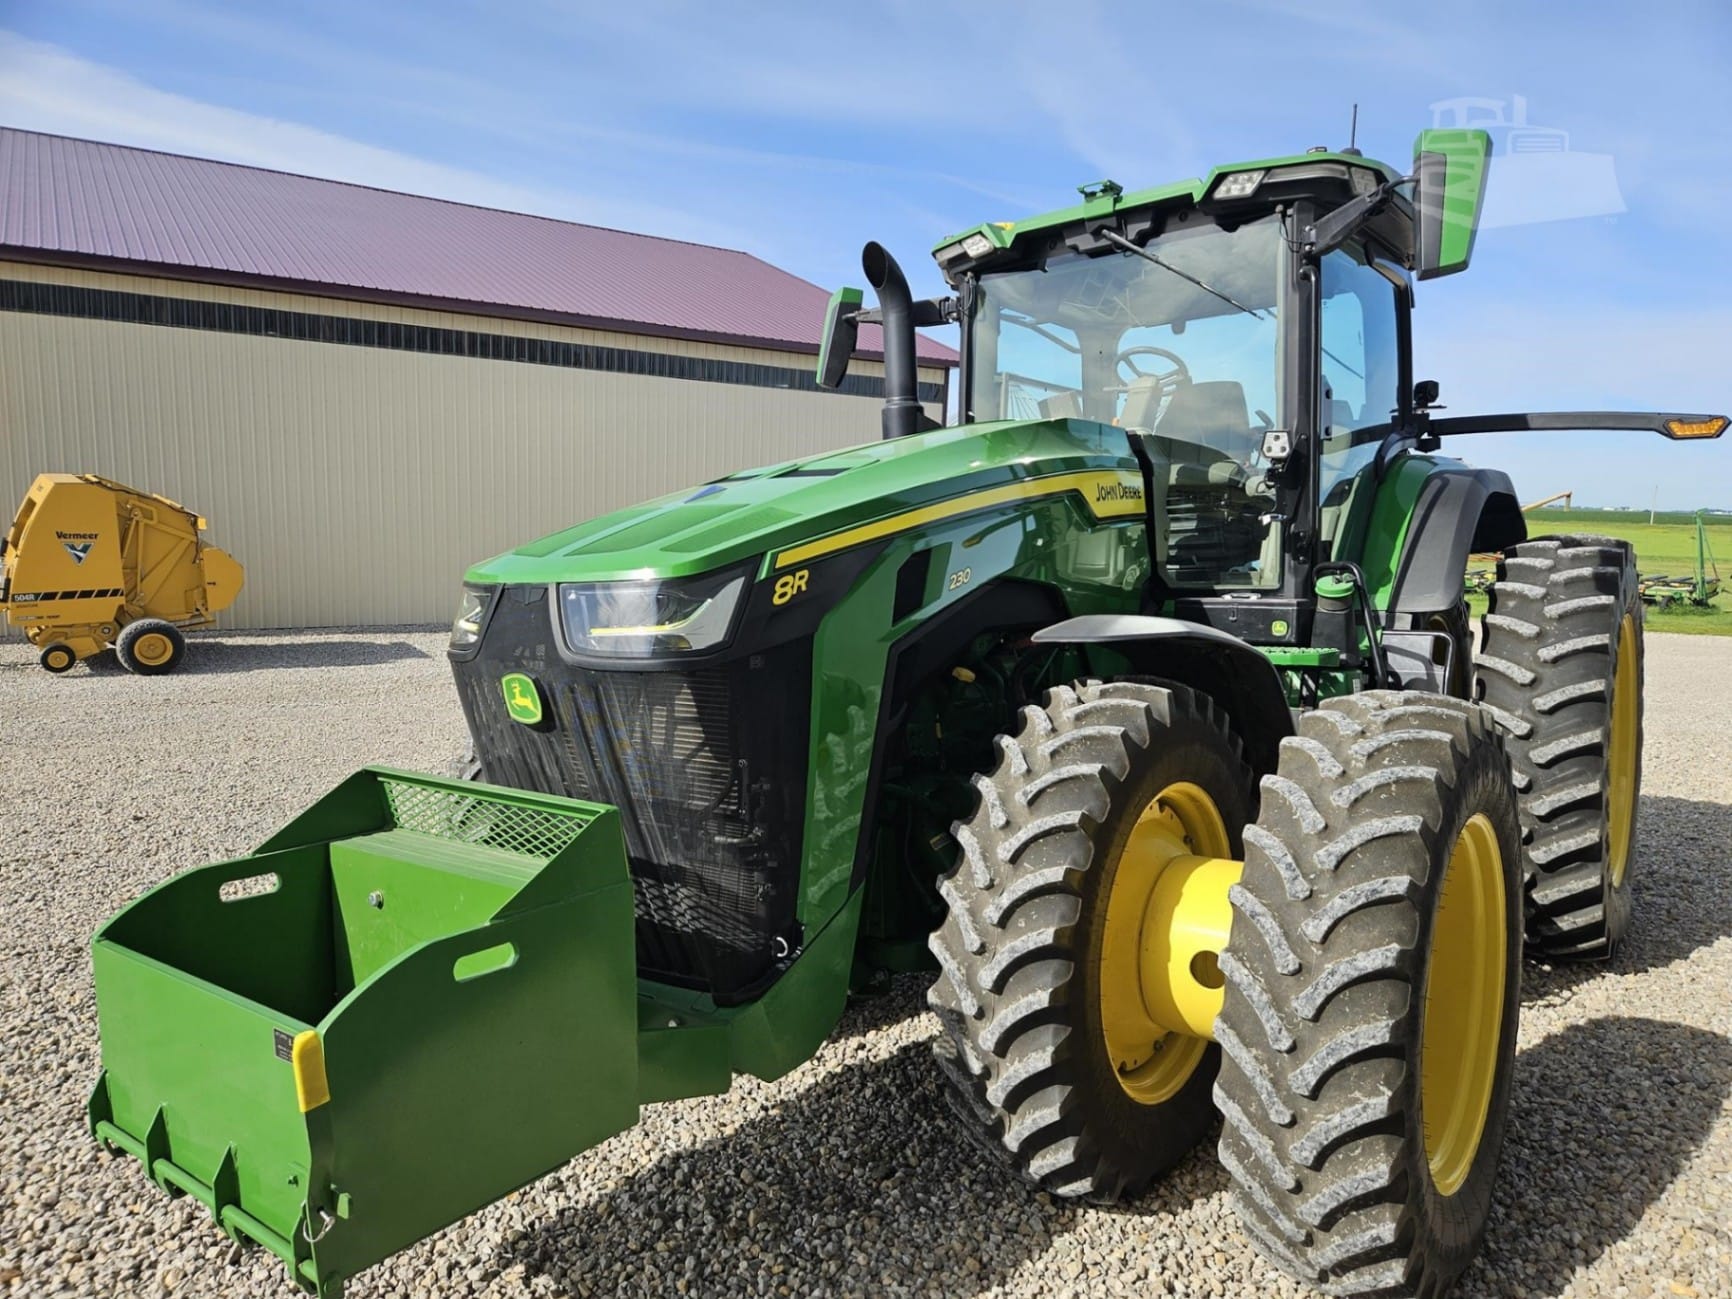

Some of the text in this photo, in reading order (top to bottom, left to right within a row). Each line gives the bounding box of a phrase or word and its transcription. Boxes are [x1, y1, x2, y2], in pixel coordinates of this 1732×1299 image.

[55, 531, 99, 540] Vermeer
[949, 567, 972, 591] 230
[772, 569, 809, 606] 8R
[14, 594, 35, 602] 504R
